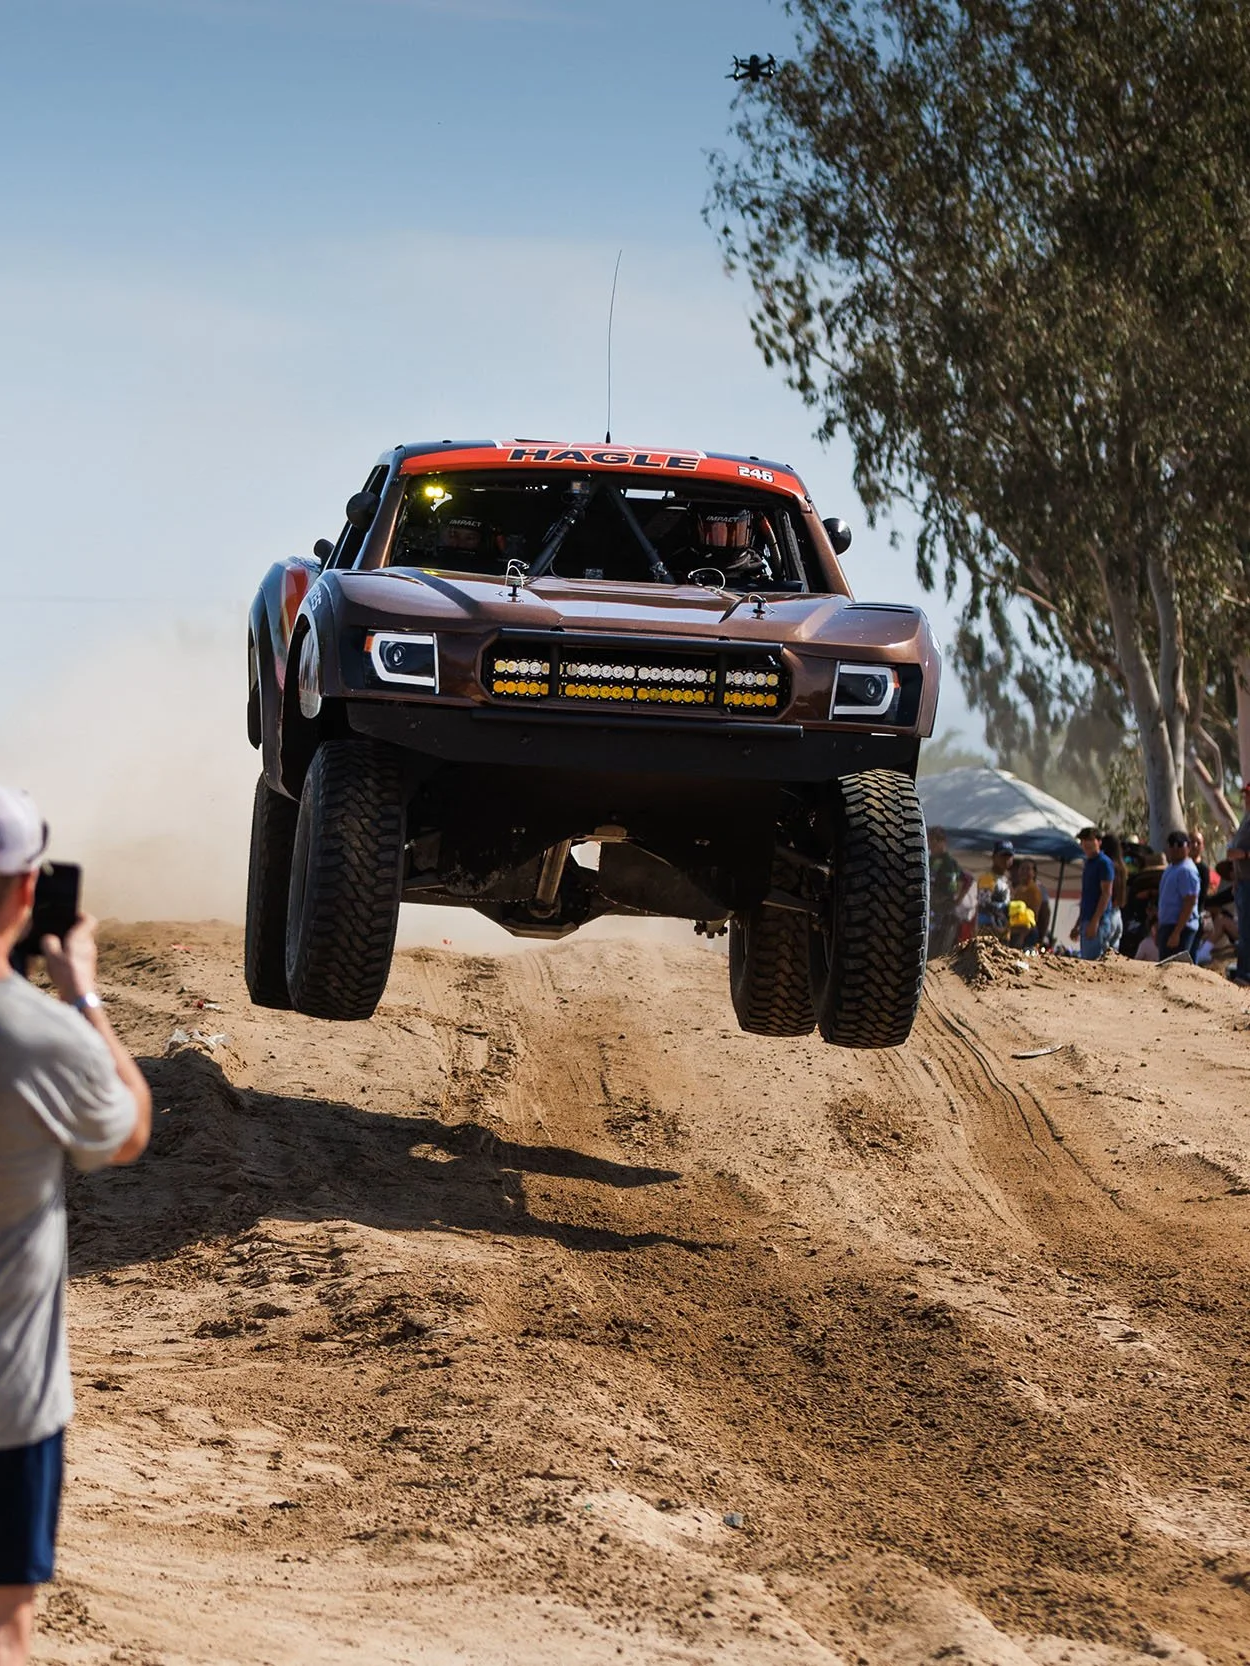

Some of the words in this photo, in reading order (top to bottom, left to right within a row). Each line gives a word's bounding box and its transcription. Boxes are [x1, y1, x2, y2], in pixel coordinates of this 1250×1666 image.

[507, 448, 700, 471] HAGLE
[737, 465, 774, 483] 246
[449, 519, 481, 527] IMPACT
[706, 515, 739, 523] IMPACT
